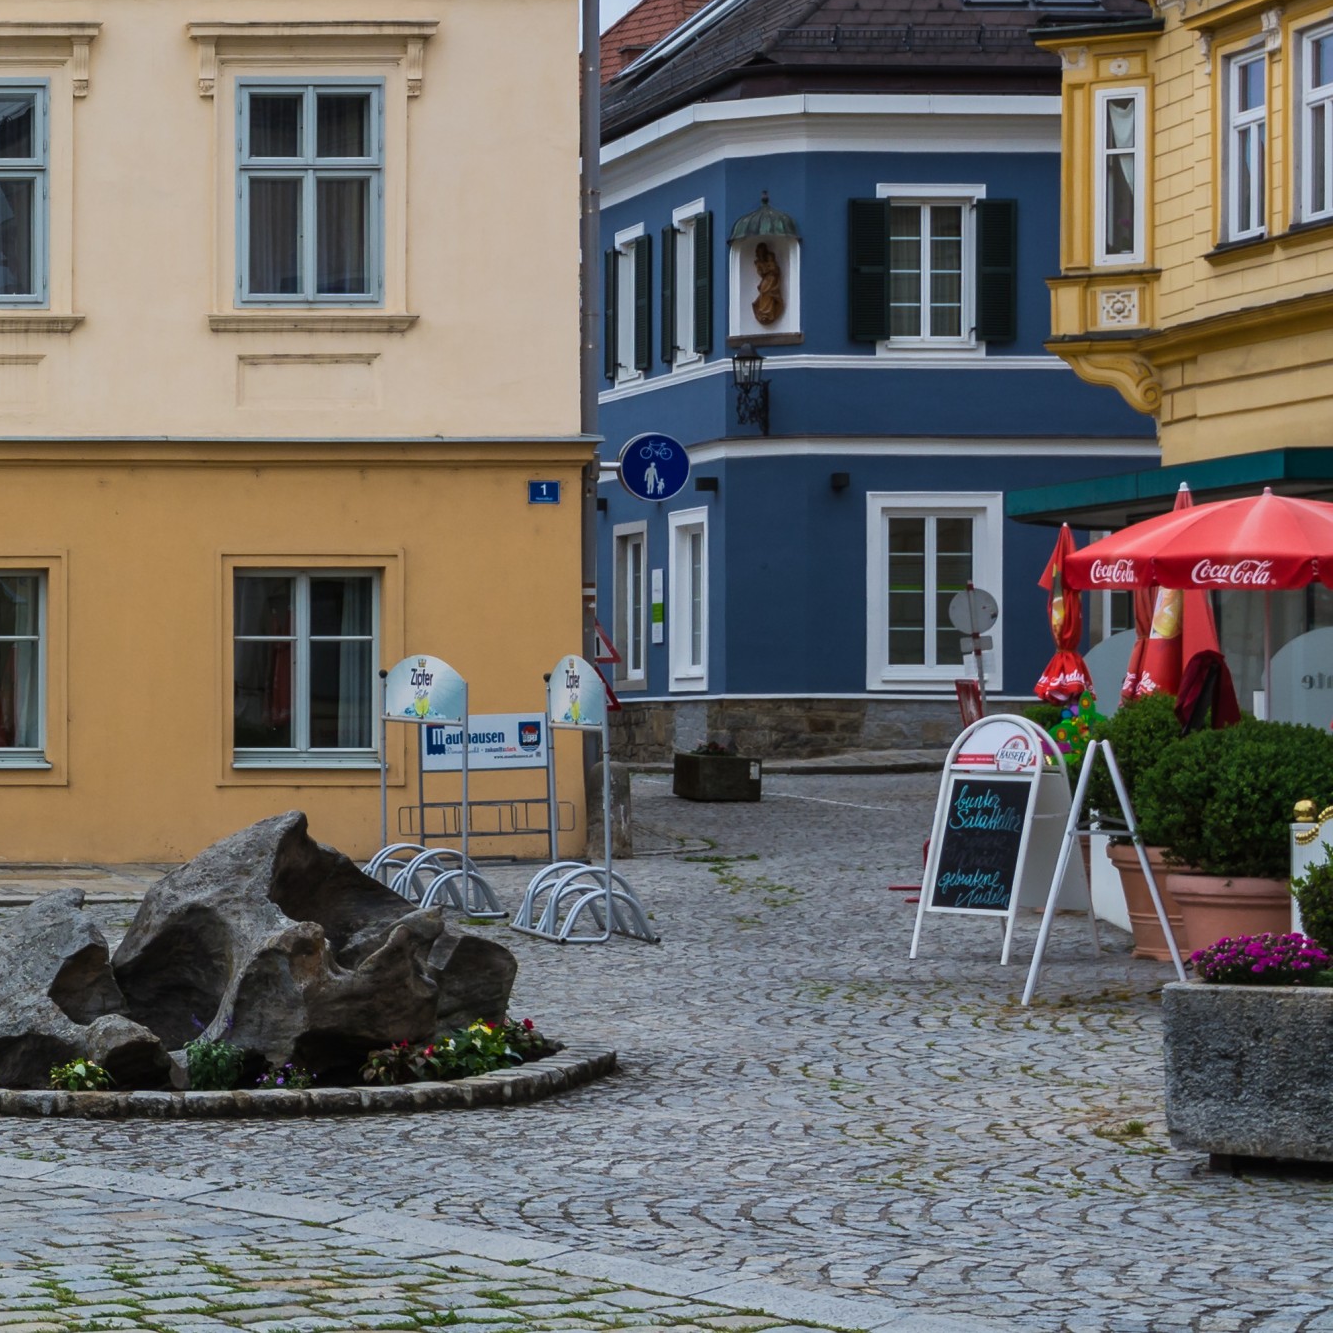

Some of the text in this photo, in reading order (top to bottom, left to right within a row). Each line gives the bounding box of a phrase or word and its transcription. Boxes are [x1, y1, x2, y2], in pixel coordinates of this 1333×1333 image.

[540, 483, 547, 496] 1
[1191, 558, 1273, 585] Coca-Cola
[410, 668, 434, 689] Zipfer
[565, 669, 581, 692] Zipfer
[999, 749, 1026, 763] KAISER
[954, 784, 1000, 809] bunter
[938, 868, 1000, 894] gebratene
